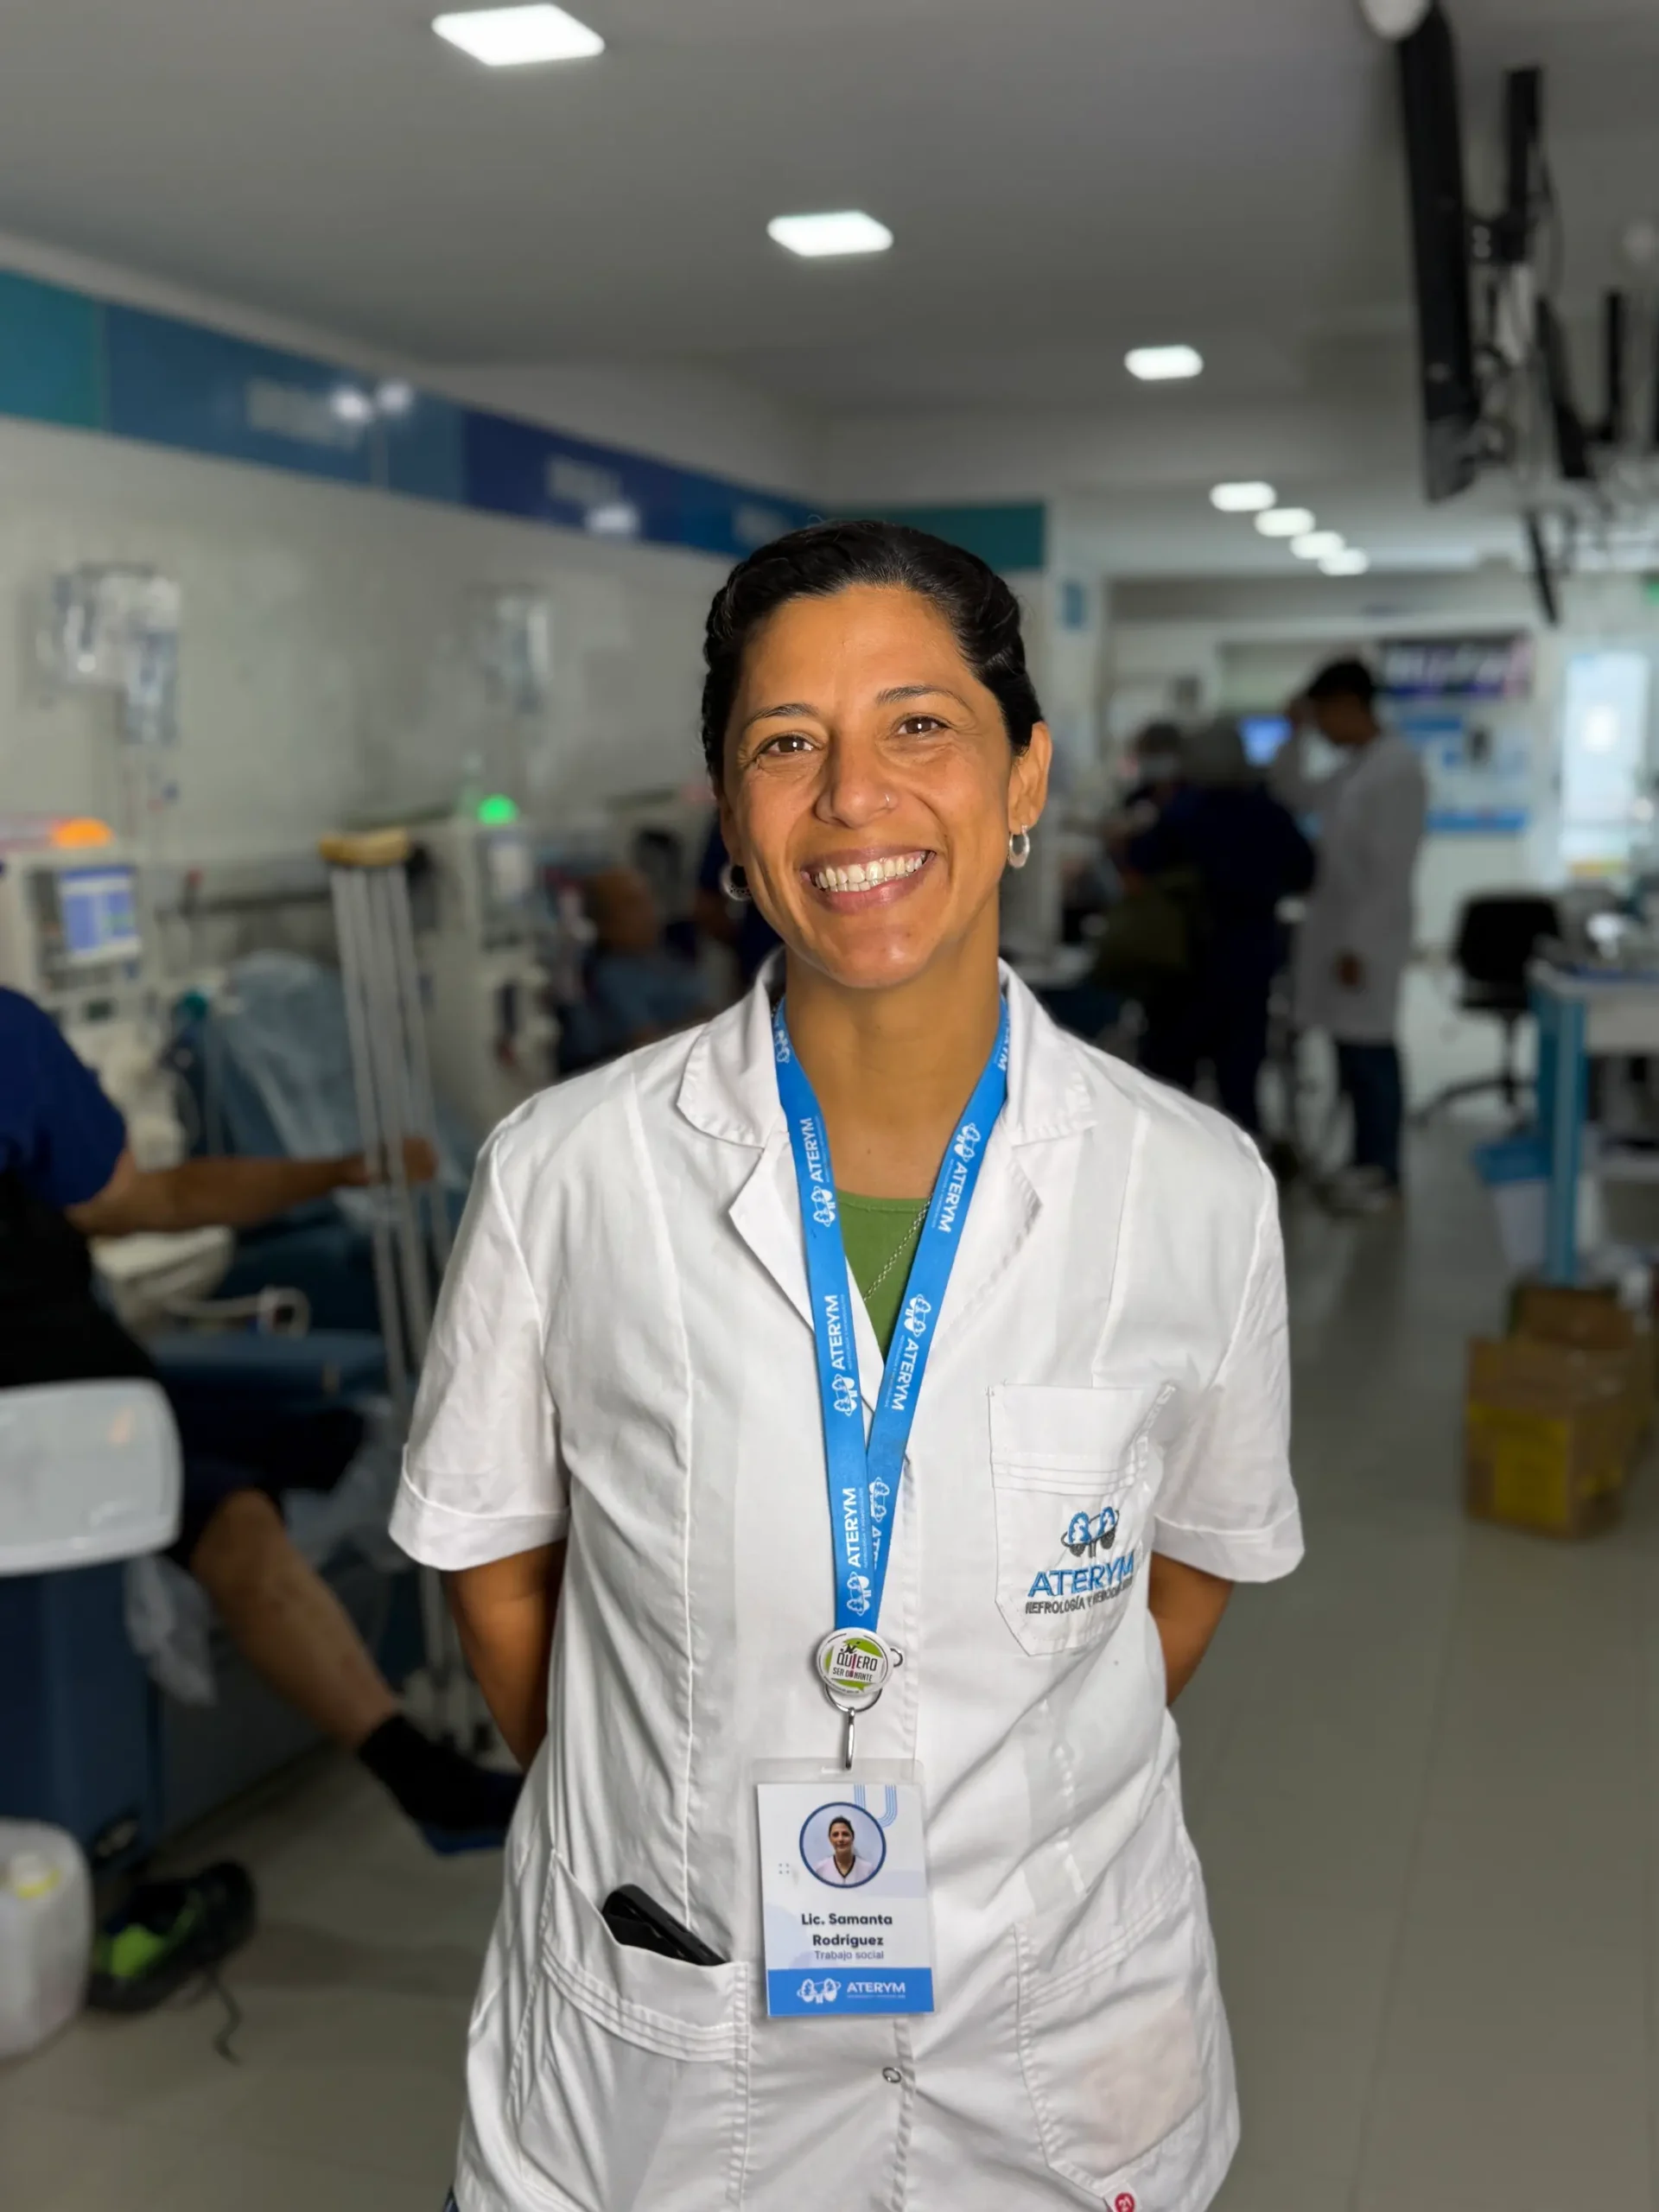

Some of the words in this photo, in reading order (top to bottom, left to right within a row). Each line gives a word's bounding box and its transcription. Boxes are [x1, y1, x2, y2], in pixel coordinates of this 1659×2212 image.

[800, 1117, 823, 1183] ATERYM
[938, 1162, 968, 1234] ATERYM
[823, 1294, 846, 1370] ATERYM
[891, 1337, 919, 1411] ATERYM
[842, 1487, 861, 1568] ATERYM
[1027, 1549, 1134, 1598] ATERYM
[833, 1667, 844, 1676] SER
[845, 1669, 874, 1682] DONANTE
[836, 1652, 878, 1671] QUIERO
[801, 1913, 825, 1925] Lic.
[829, 1913, 893, 1925] Samanta
[812, 1934, 884, 1948] Rodríguez
[815, 1949, 852, 1961] Trabajo
[855, 1950, 884, 1960] social
[847, 1981, 906, 1993] ATERYM
